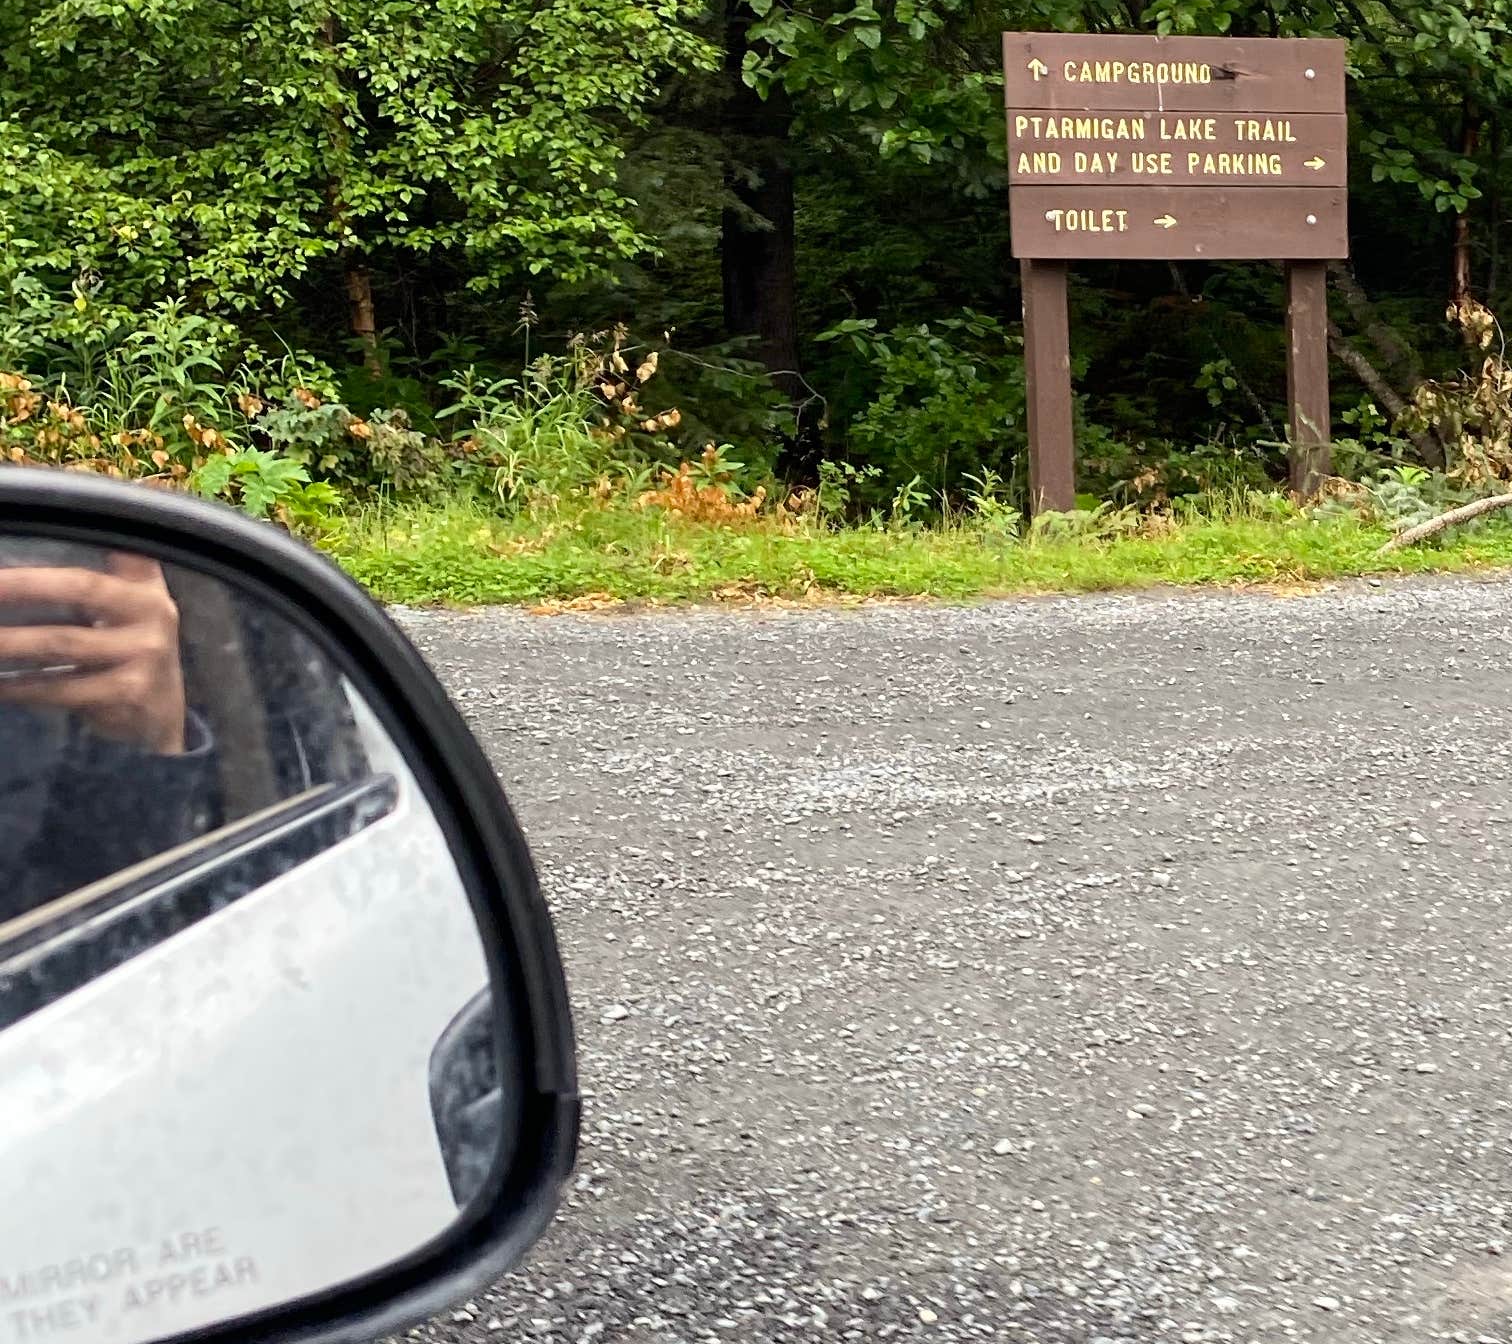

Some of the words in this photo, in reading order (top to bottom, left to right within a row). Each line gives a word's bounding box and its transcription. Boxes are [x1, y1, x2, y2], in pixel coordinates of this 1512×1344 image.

[1063, 61, 1213, 84] CAMPGROUND
[1015, 115, 1145, 141] PTARMIGAN
[1160, 118, 1217, 141] LAKE
[1234, 119, 1297, 142] TRAIL
[1017, 151, 1062, 174] AND
[1074, 152, 1119, 175] DAY
[1131, 152, 1173, 175] USE
[1187, 152, 1282, 175] PARKING
[1052, 209, 1129, 232] TOILET
[158, 1226, 226, 1268] ARE
[9, 1296, 102, 1340] THEY
[122, 1254, 260, 1311] APPEAR
